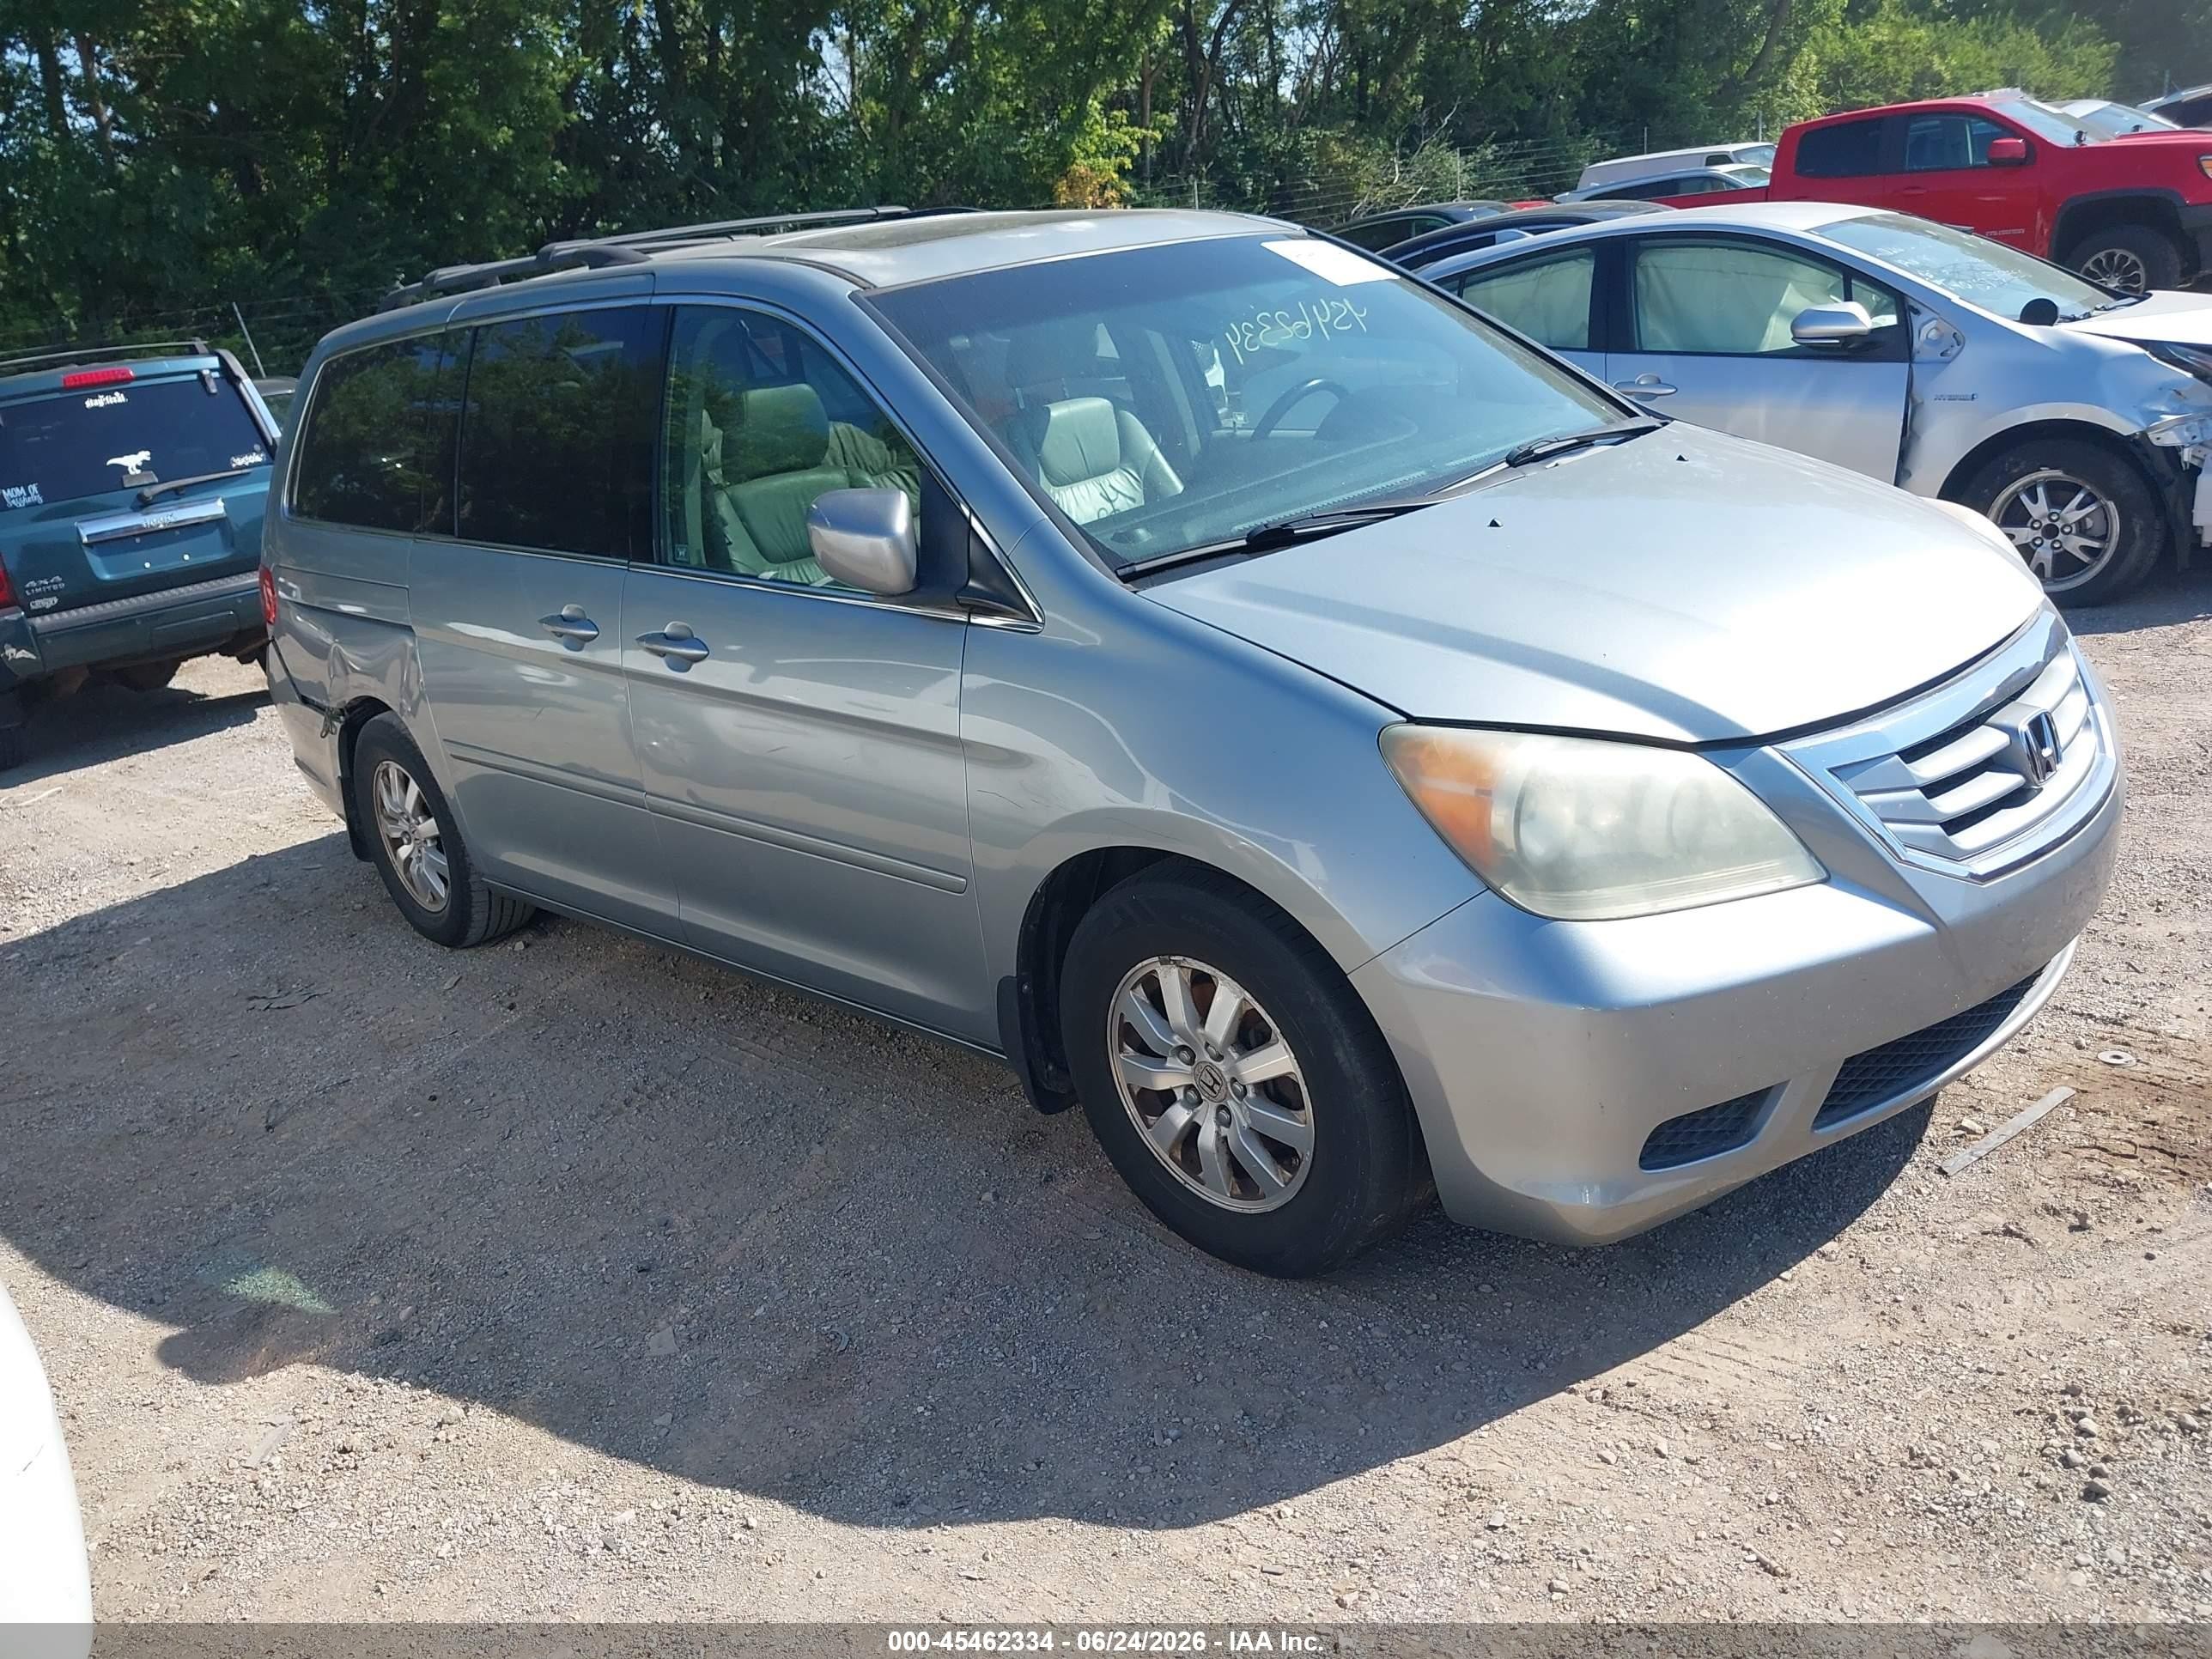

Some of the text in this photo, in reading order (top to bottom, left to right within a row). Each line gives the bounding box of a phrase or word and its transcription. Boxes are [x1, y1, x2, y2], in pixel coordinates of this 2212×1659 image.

[2, 483, 39, 499] MOM OF
[25, 582, 65, 596] LIMITED
